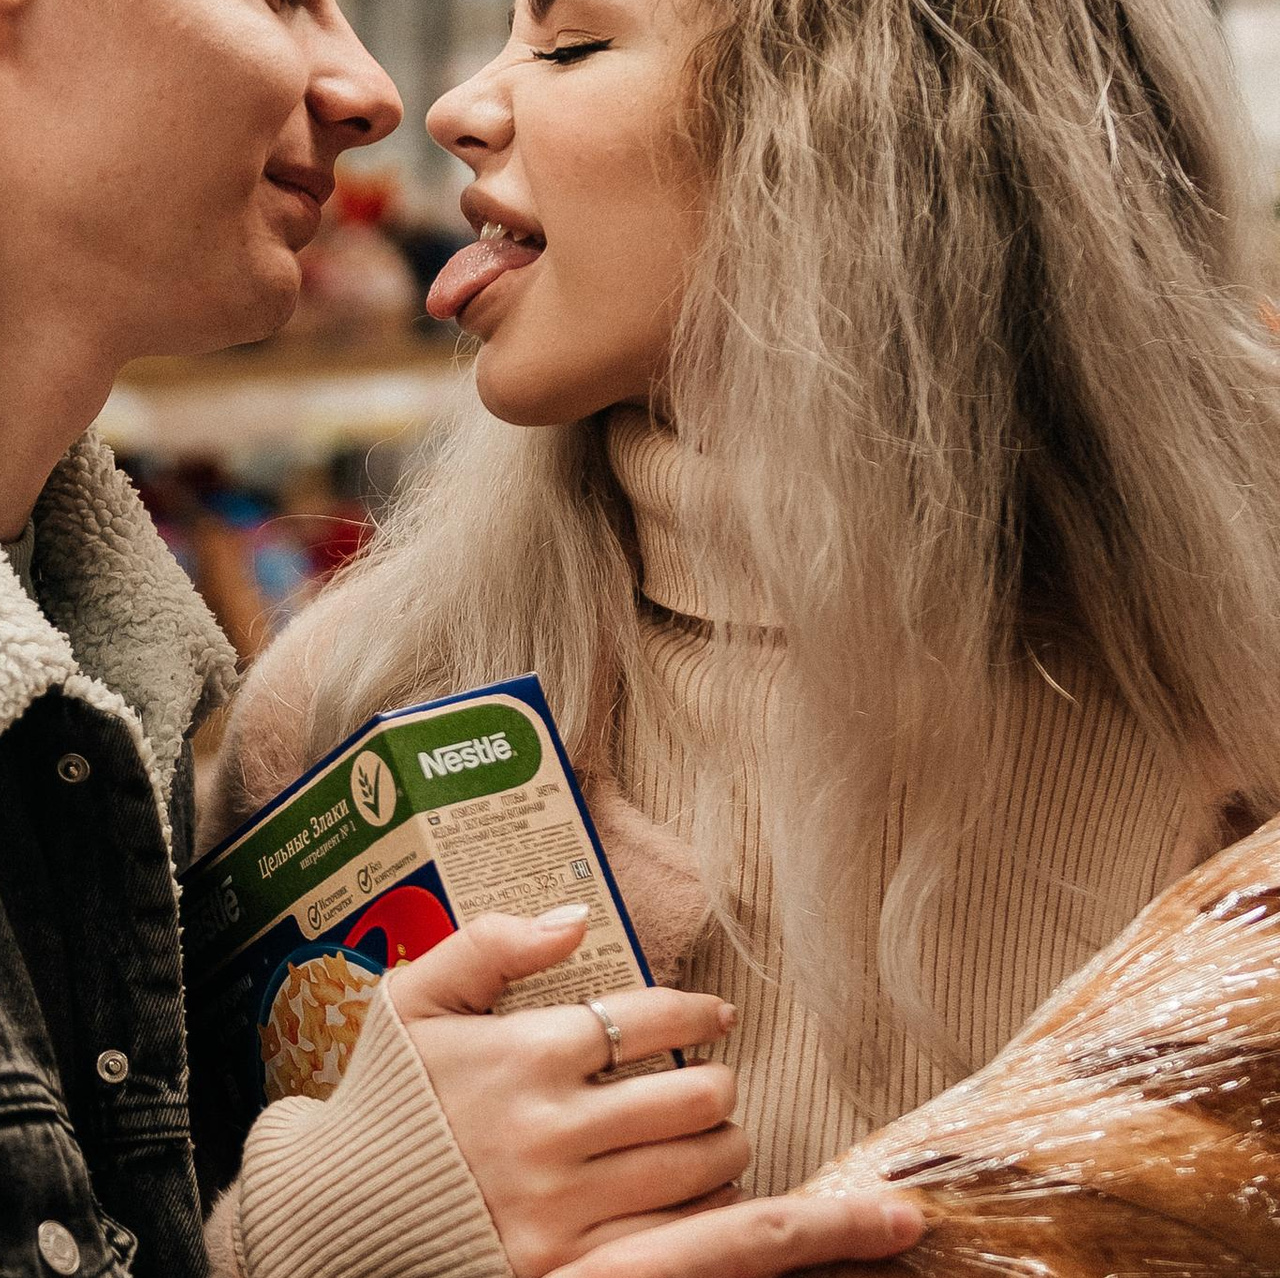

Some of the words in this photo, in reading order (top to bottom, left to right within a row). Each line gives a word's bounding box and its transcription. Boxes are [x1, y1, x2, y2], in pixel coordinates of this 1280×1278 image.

[417, 731, 513, 779] Nestlé
[258, 829, 311, 879] Цельные
[310, 798, 350, 839] Злаки
[300, 833, 340, 870] ингредиент
[458, 895, 497, 912] МАССА
[534, 874, 559, 891] 325
